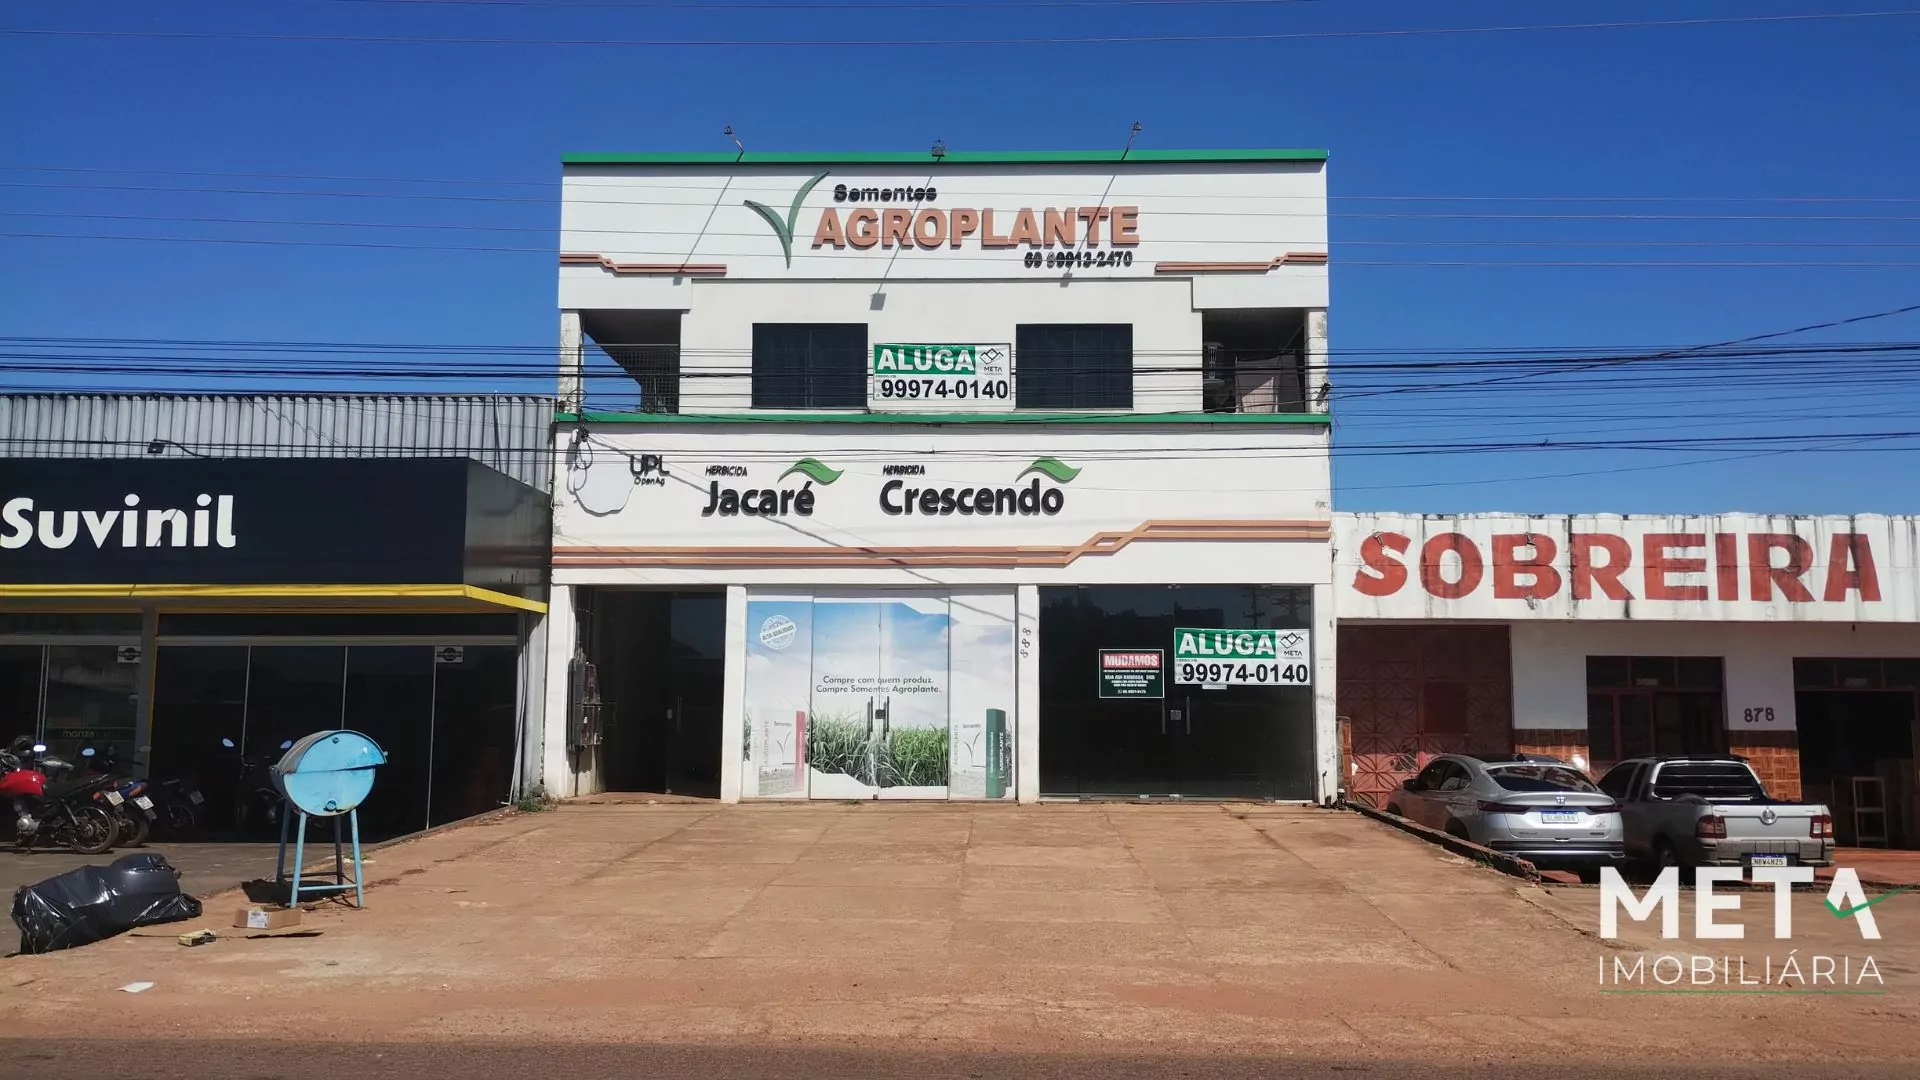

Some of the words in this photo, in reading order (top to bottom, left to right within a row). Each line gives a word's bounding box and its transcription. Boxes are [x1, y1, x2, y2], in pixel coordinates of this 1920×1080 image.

[833, 184, 938, 202] Sementes
[811, 205, 1141, 250] AGROPLANTE
[877, 347, 975, 372] ALUGA
[881, 379, 1008, 399] 99974-0140
[630, 454, 670, 477] UPL
[705, 465, 748, 477] HERBICIDA
[882, 464, 926, 476] HERBICIDA
[701, 481, 815, 517] Jacaré
[879, 478, 1065, 516] Crescendo
[0, 493, 236, 549] Suvinil
[1352, 531, 1882, 603] SOBREIRA
[1178, 632, 1275, 656] ALUGA
[1104, 655, 1158, 666] MUDAMOS
[823, 675, 855, 685] Compre
[877, 677, 901, 685] quem
[903, 675, 935, 685] produz.
[1182, 663, 1309, 683] 99974-0140
[816, 684, 849, 694] Compre
[850, 684, 890, 693] Sementes
[891, 684, 942, 694] Agroplante.
[1744, 707, 1775, 722] 878
